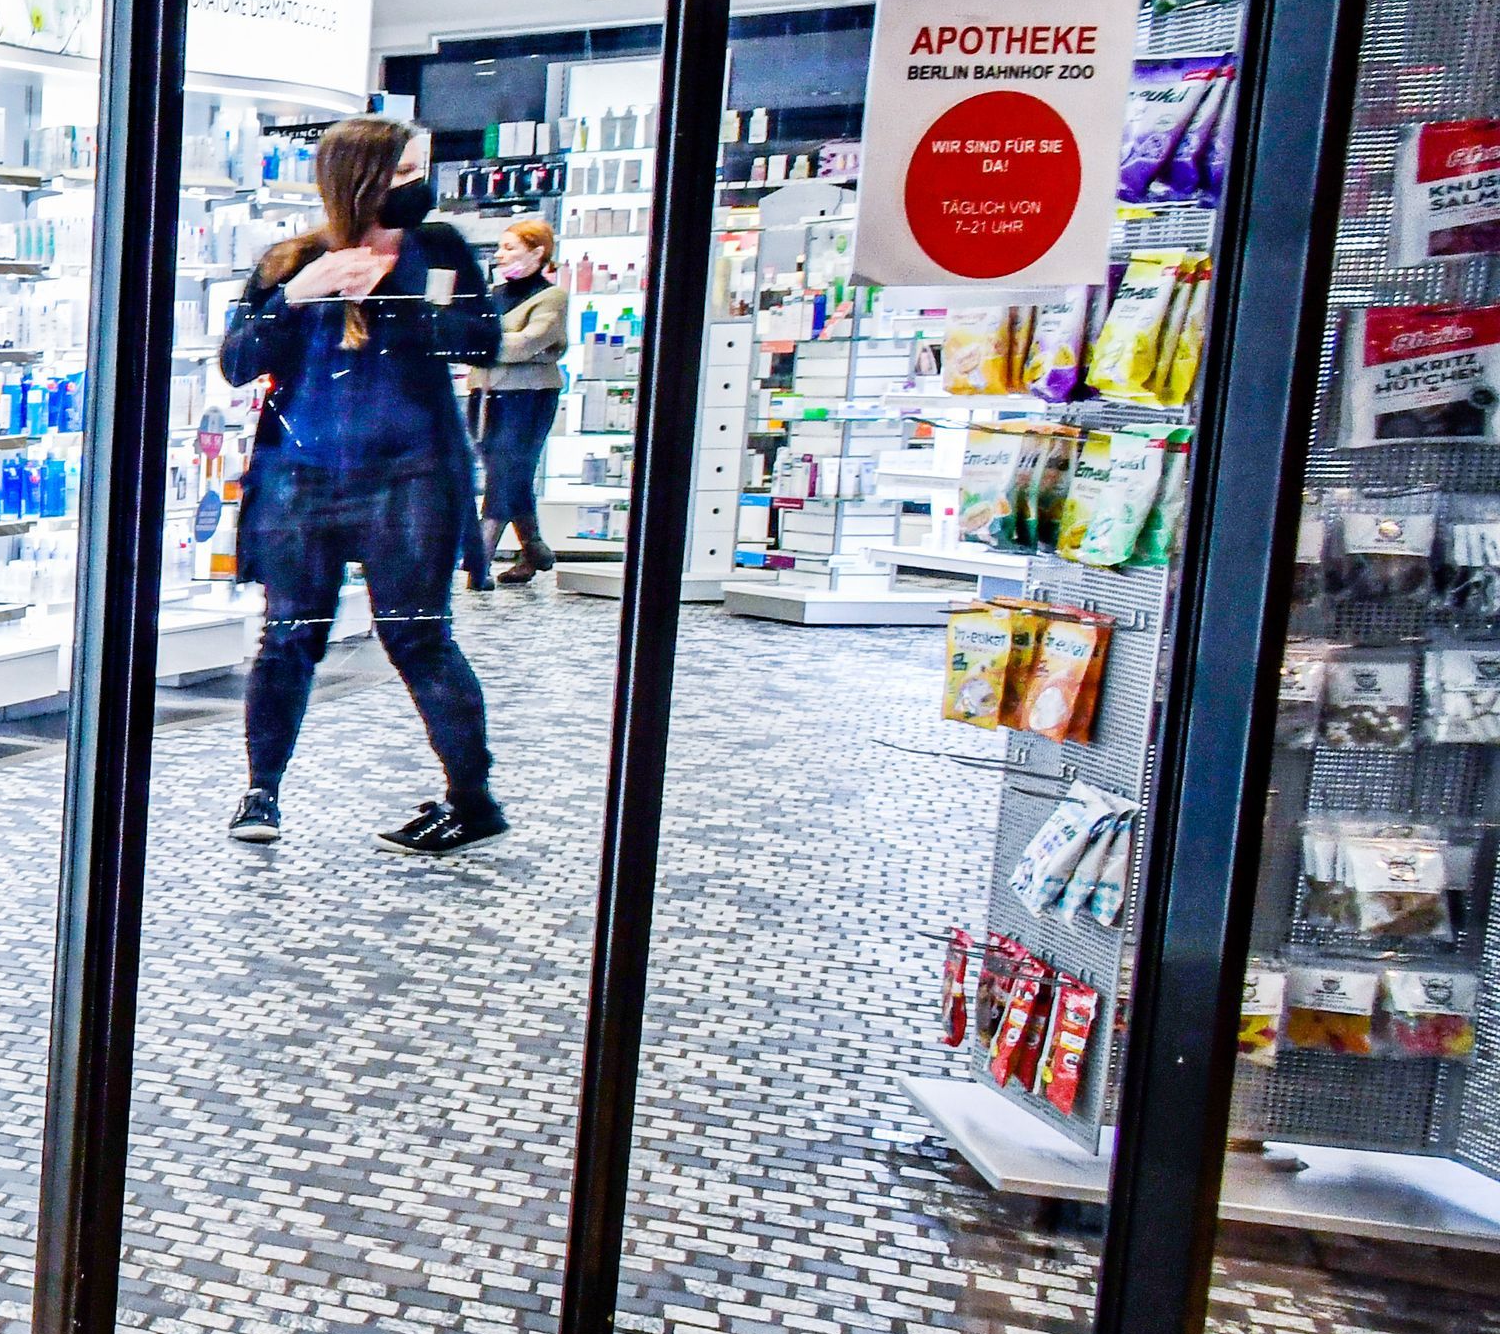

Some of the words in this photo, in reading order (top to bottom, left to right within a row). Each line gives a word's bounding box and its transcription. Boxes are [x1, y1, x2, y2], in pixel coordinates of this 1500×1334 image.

[908, 25, 1098, 55] APOTHEKE
[907, 65, 969, 81] BERLIN
[972, 65, 1054, 80] BAHNHOF
[1057, 64, 1095, 80] ZOO
[931, 139, 961, 154] WIR
[963, 139, 1001, 154] SIND
[1004, 137, 1036, 154] FÜR
[1038, 139, 1064, 154] SIE
[981, 158, 1009, 174] DA!
[940, 198, 1006, 216] TÄGLICH
[1008, 200, 1042, 215] VON
[991, 220, 1024, 234] UHR
[1384, 352, 1478, 379] LAKRITZ
[1373, 363, 1487, 397] HÜTCHEN
